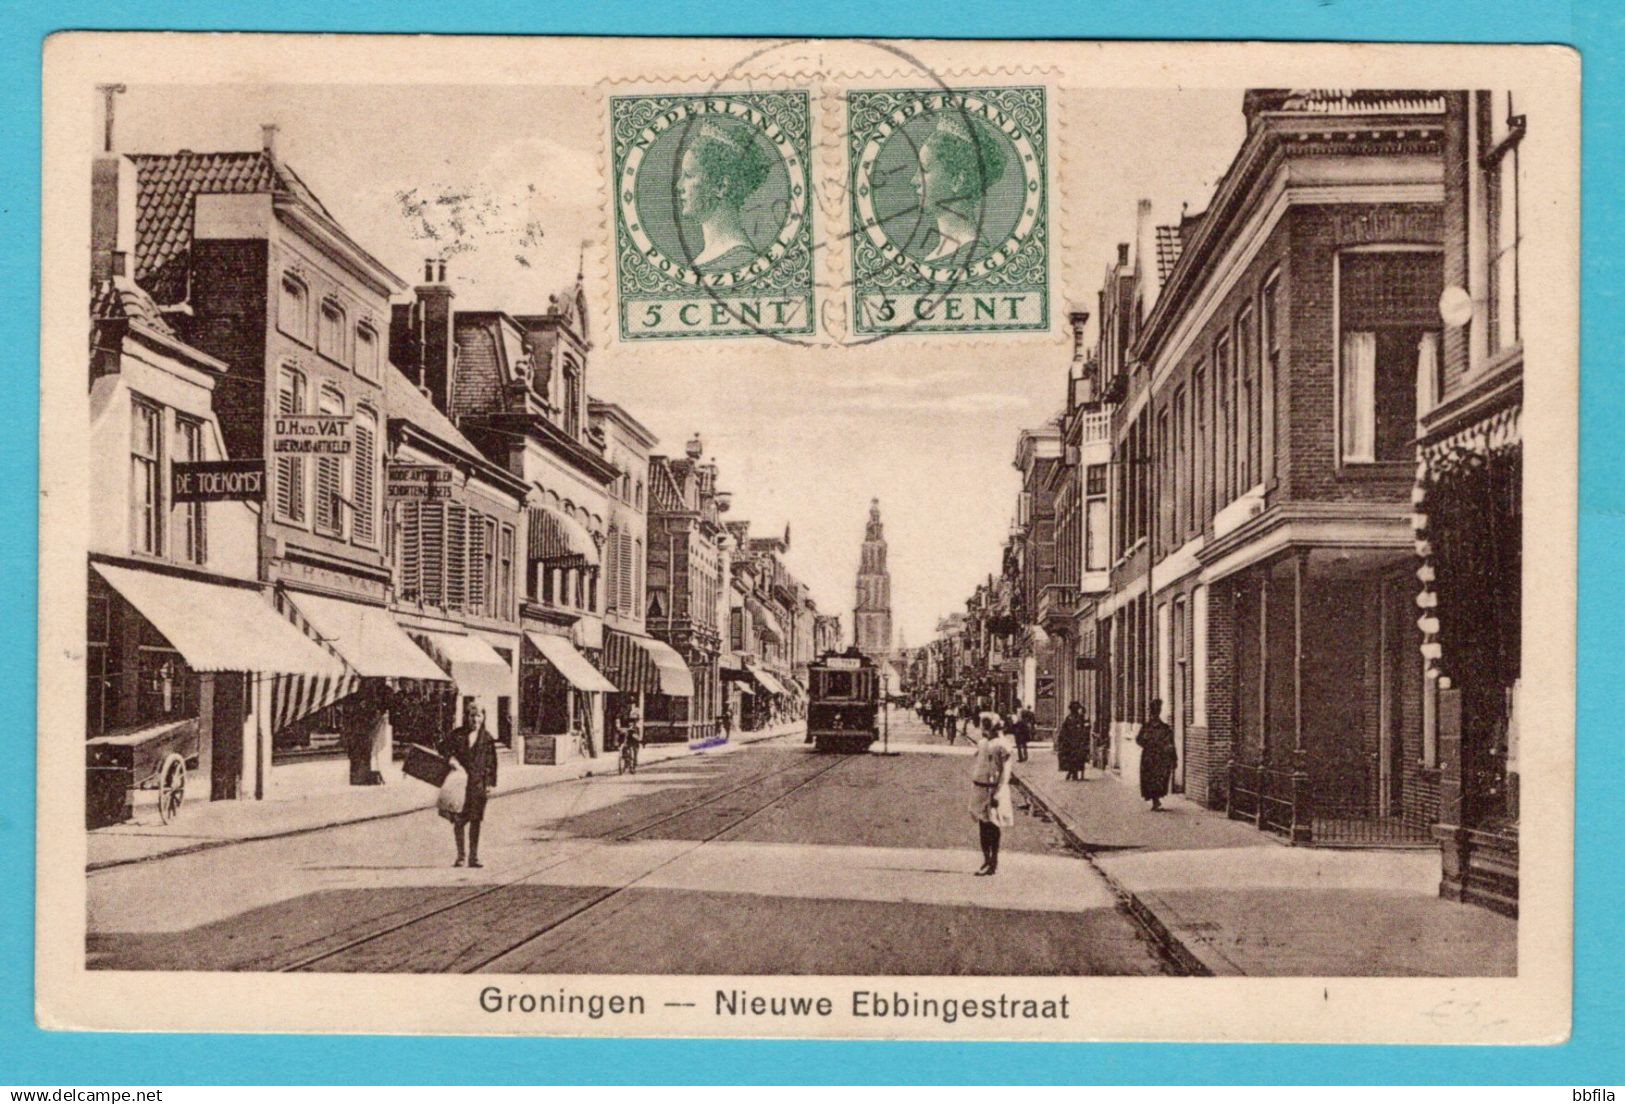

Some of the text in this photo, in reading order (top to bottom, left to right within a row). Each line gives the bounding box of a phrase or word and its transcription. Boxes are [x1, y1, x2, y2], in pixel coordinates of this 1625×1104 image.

[636, 101, 786, 150] NEDERLAND
[872, 96, 1022, 144] NEDERLAND
[646, 238, 792, 286] POSTZEGEL
[880, 233, 1027, 281] POSTZEGEL
[642, 301, 791, 328] 5 CENT
[877, 296, 1026, 322] 5 CENT
[176, 470, 263, 493] DE TOEKOMST
[479, 986, 645, 1019] Groningen
[715, 990, 832, 1016] Nieuwe
[852, 991, 1070, 1023] Ebbingestraat
